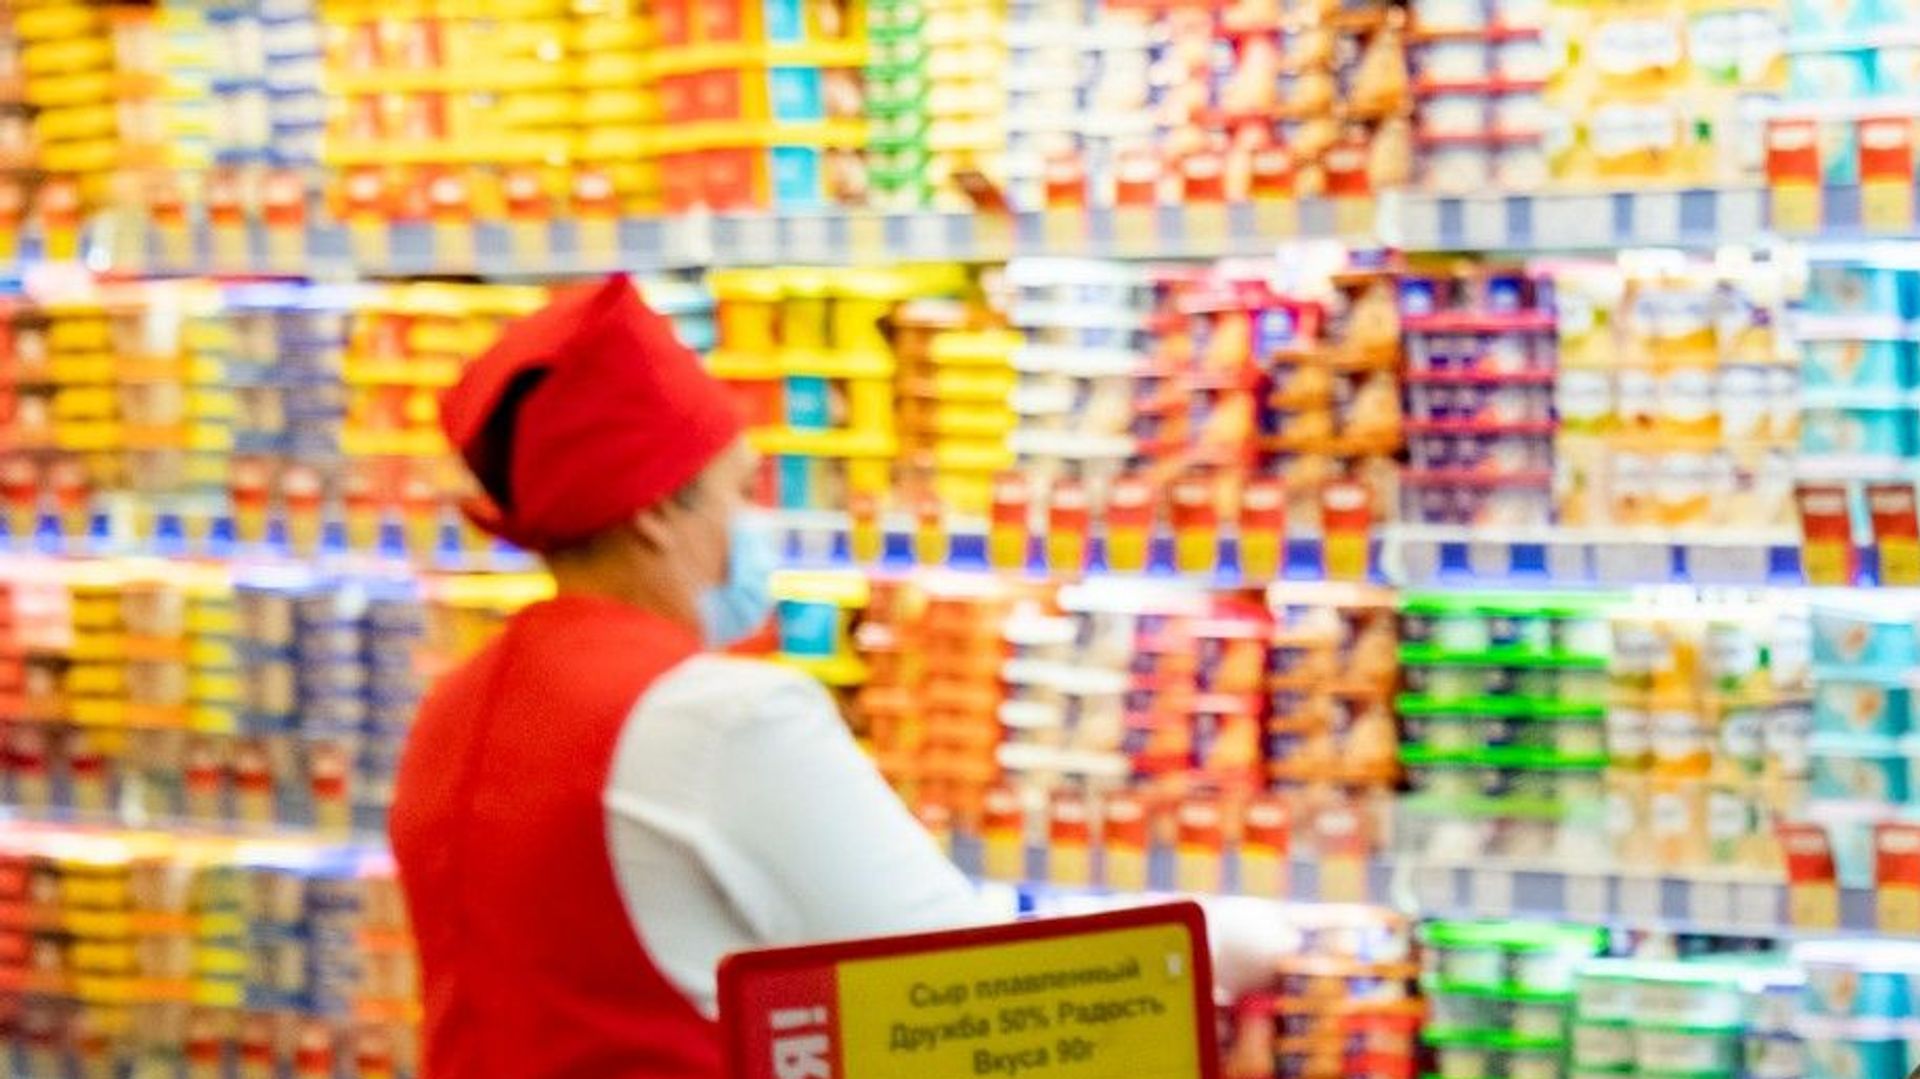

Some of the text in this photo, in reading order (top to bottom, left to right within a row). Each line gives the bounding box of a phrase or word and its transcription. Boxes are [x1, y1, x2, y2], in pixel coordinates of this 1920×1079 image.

[909, 957, 1140, 1009] Сыр плавленный
[890, 995, 1166, 1051] Дружба 50% Радость
[973, 1047, 1049, 1076] Вкуса
